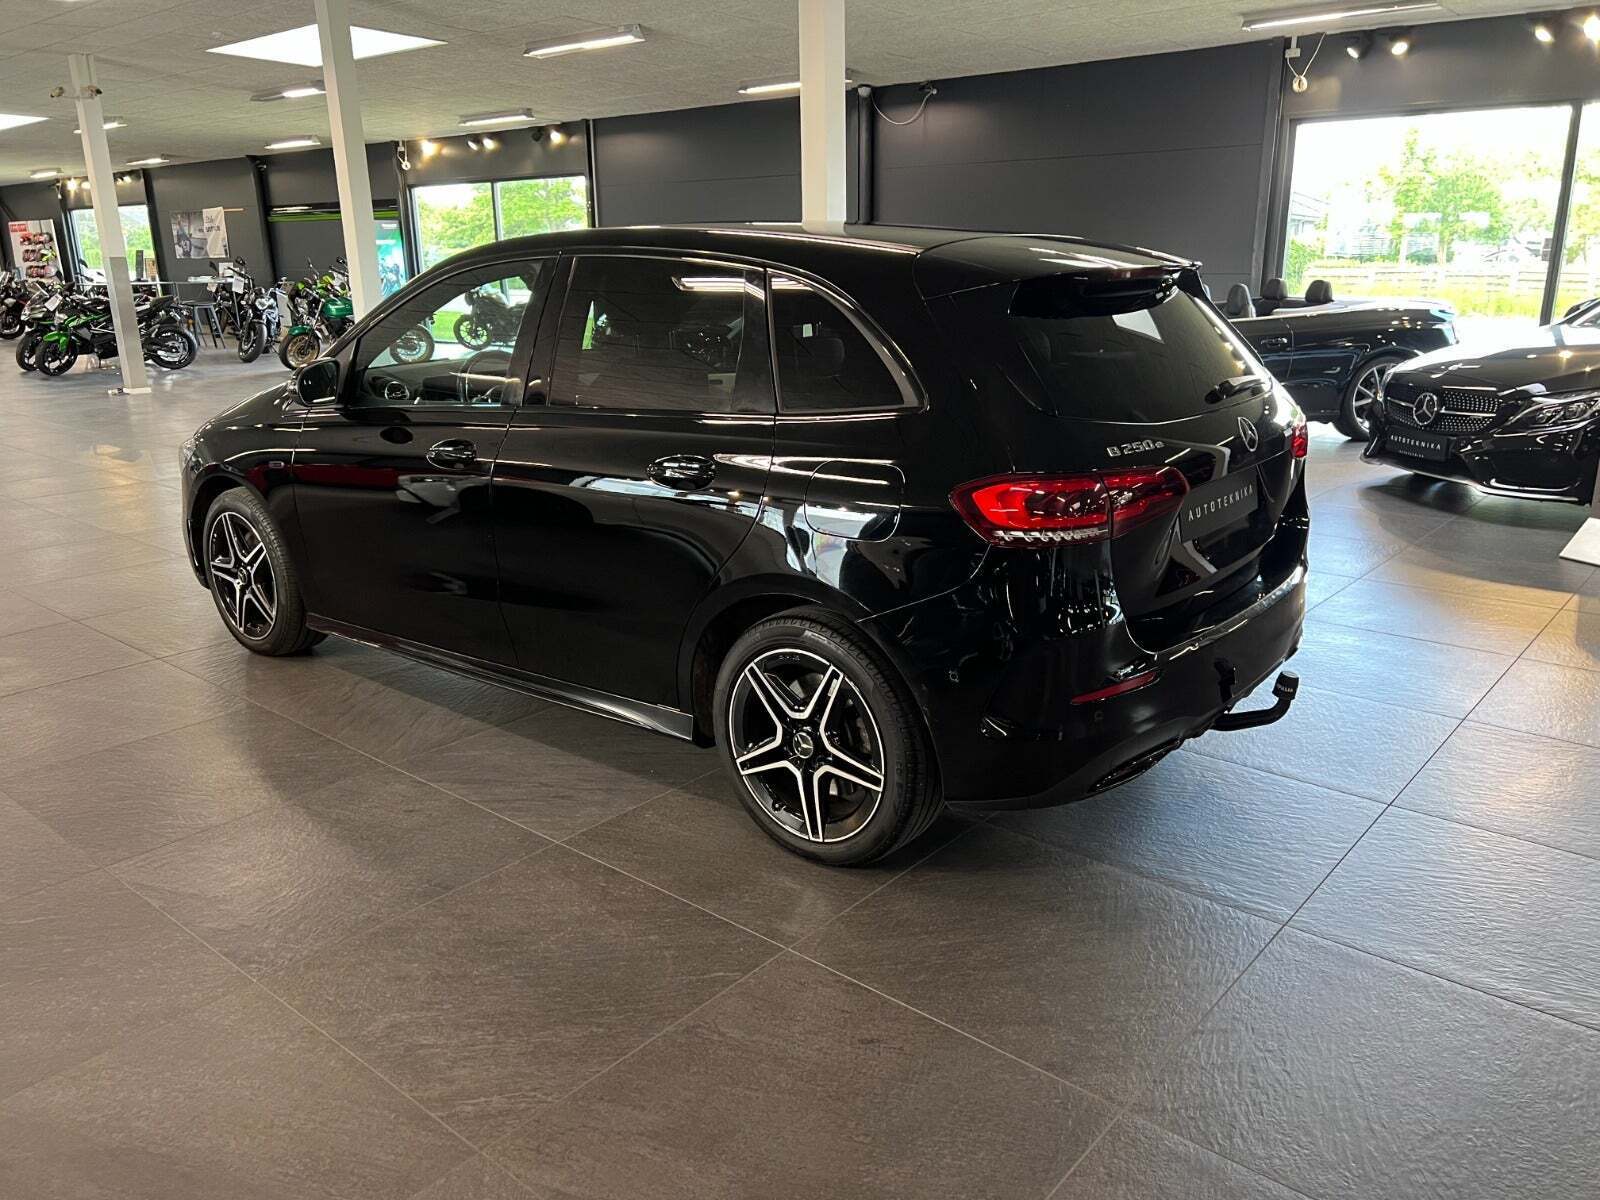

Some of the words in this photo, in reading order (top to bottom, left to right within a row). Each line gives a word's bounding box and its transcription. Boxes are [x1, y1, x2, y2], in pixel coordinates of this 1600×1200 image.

[1106, 446, 1122, 457] B
[1121, 439, 1165, 455] 250e
[1390, 434, 1441, 451] AUTOTEKNIKA
[1188, 483, 1254, 522] AUTOTEKNIKA
